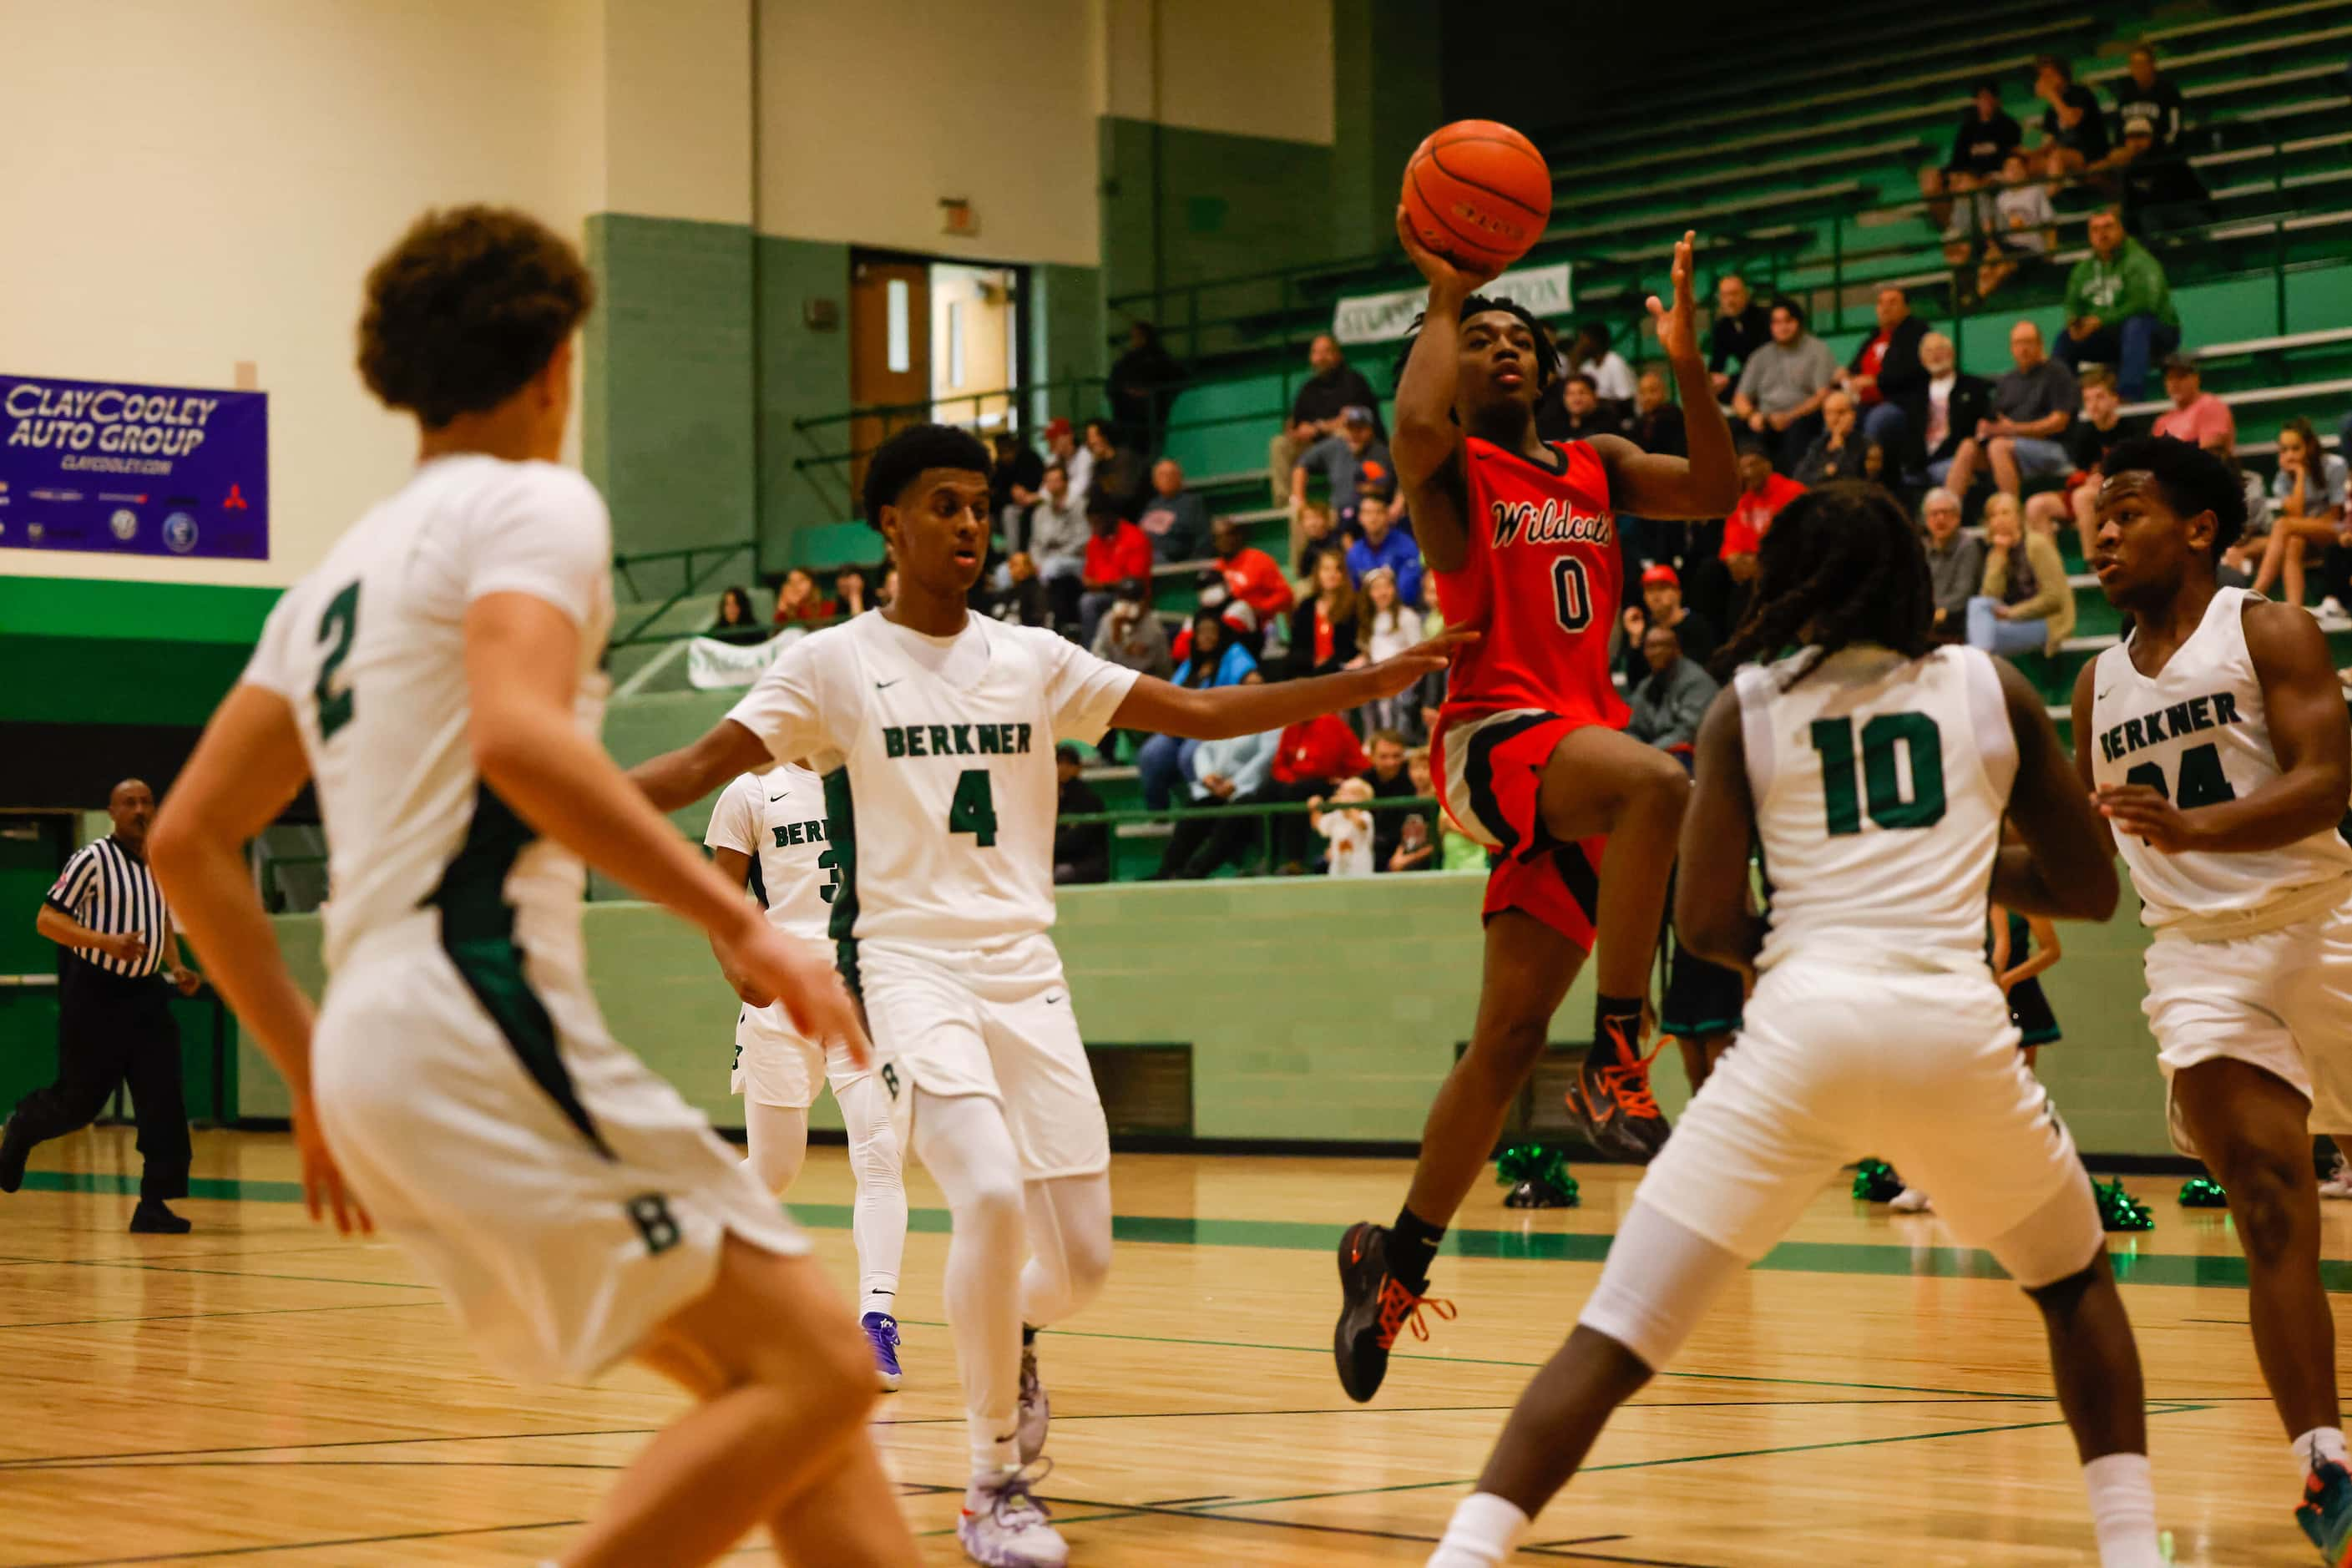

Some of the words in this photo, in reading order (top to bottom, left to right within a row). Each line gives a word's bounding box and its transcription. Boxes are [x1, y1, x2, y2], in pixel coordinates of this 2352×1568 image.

[8, 420, 94, 451] AUTO
[99, 424, 205, 457] GROUP
[1491, 498, 1613, 549] Wildcats
[1550, 554, 1593, 634] 0
[315, 579, 361, 743] 2
[883, 722, 1031, 758] BERKNER
[1810, 711, 1947, 837] 10
[949, 769, 998, 847] 4
[627, 1191, 681, 1255] B
